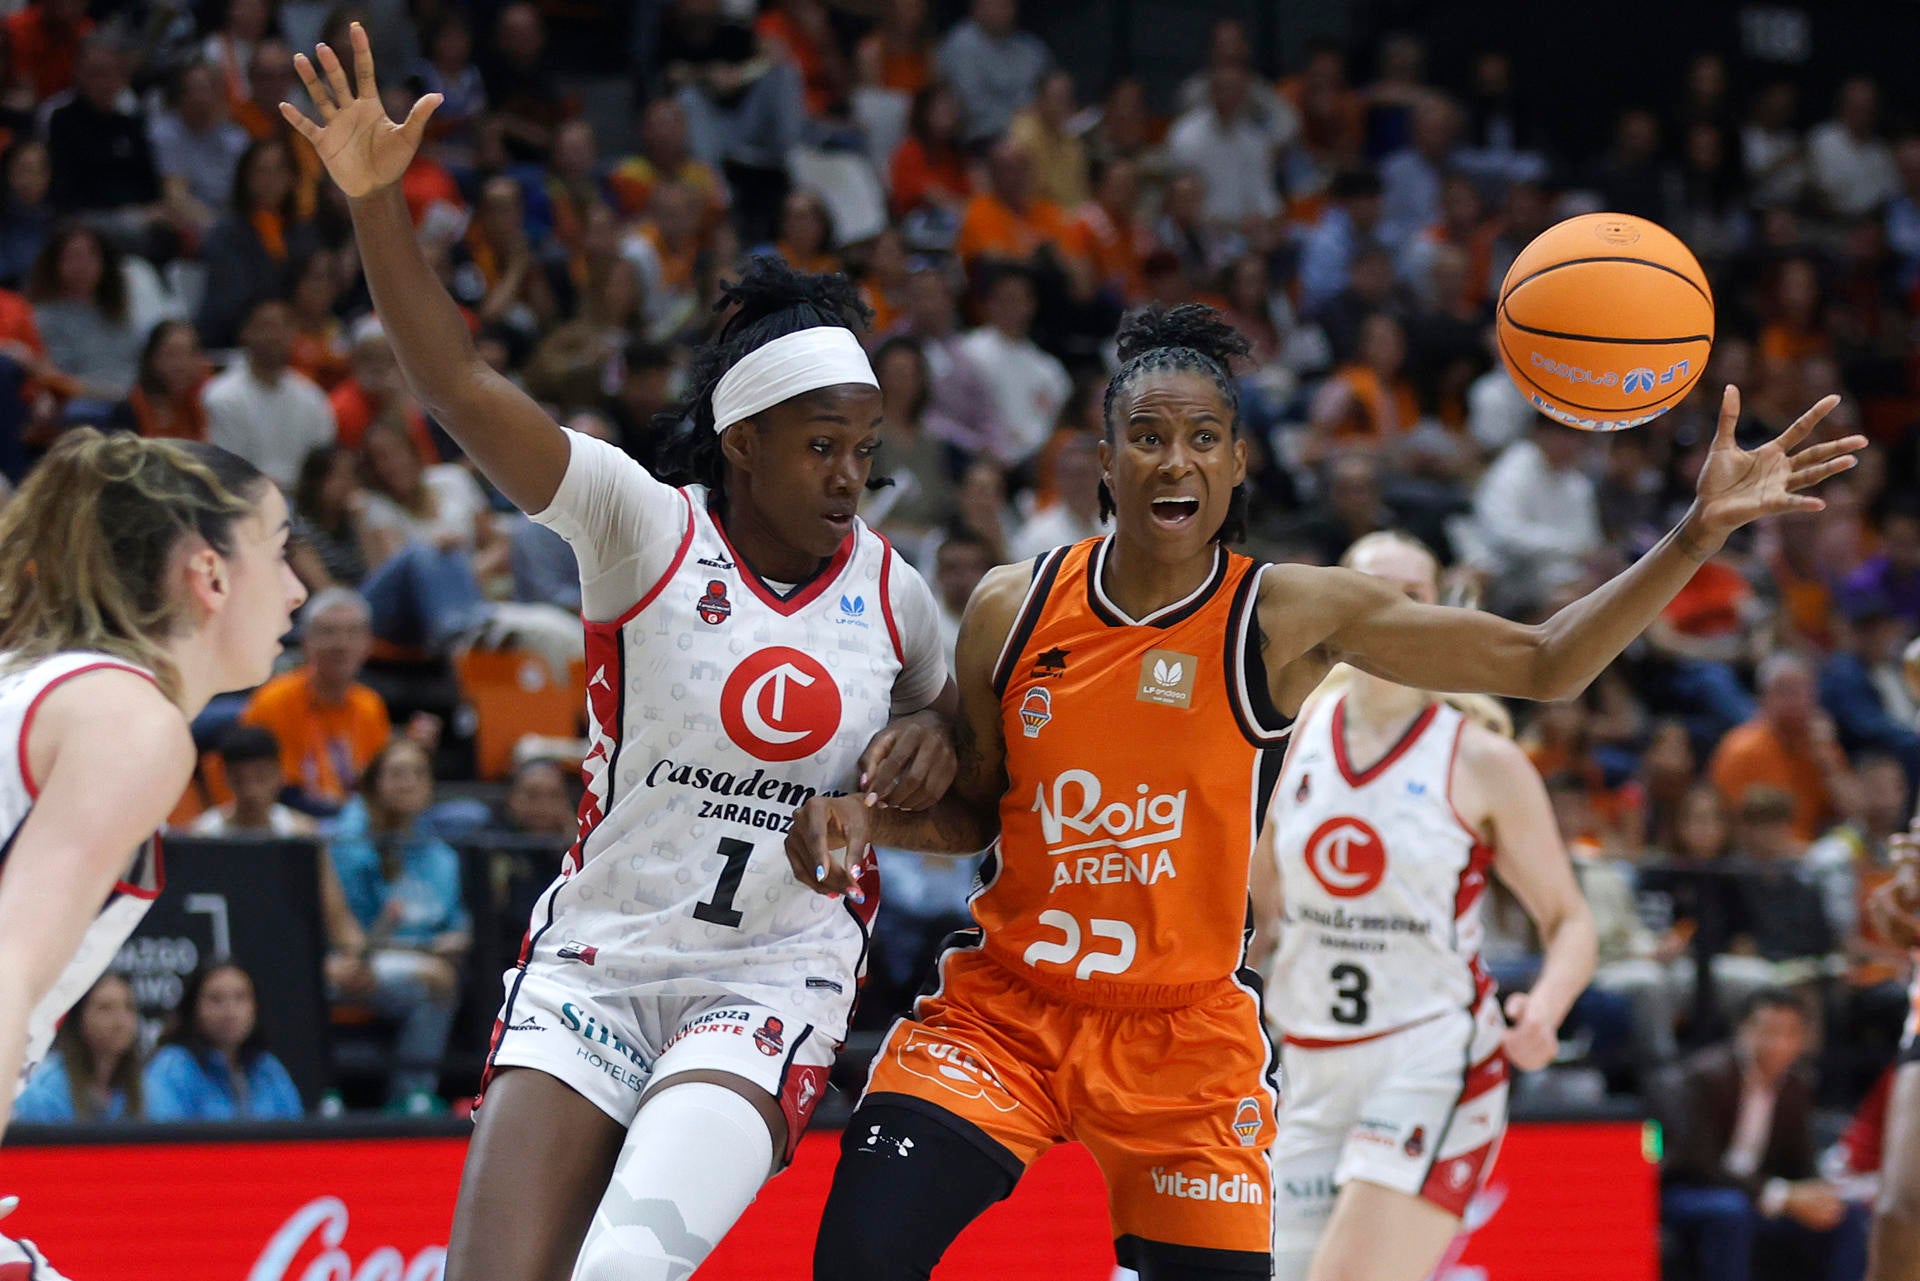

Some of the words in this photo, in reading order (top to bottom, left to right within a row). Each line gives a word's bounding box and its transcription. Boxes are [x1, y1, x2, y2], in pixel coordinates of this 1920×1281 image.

[1530, 351, 1618, 386] endesa
[1659, 359, 1690, 385] LF
[698, 800, 795, 834] ZARAGOZ
[1031, 768, 1187, 856] Roig
[692, 836, 755, 928] 1
[1049, 848, 1177, 894] ARENA
[1331, 962, 1371, 1026] 3
[576, 1047, 645, 1093] HOTELES
